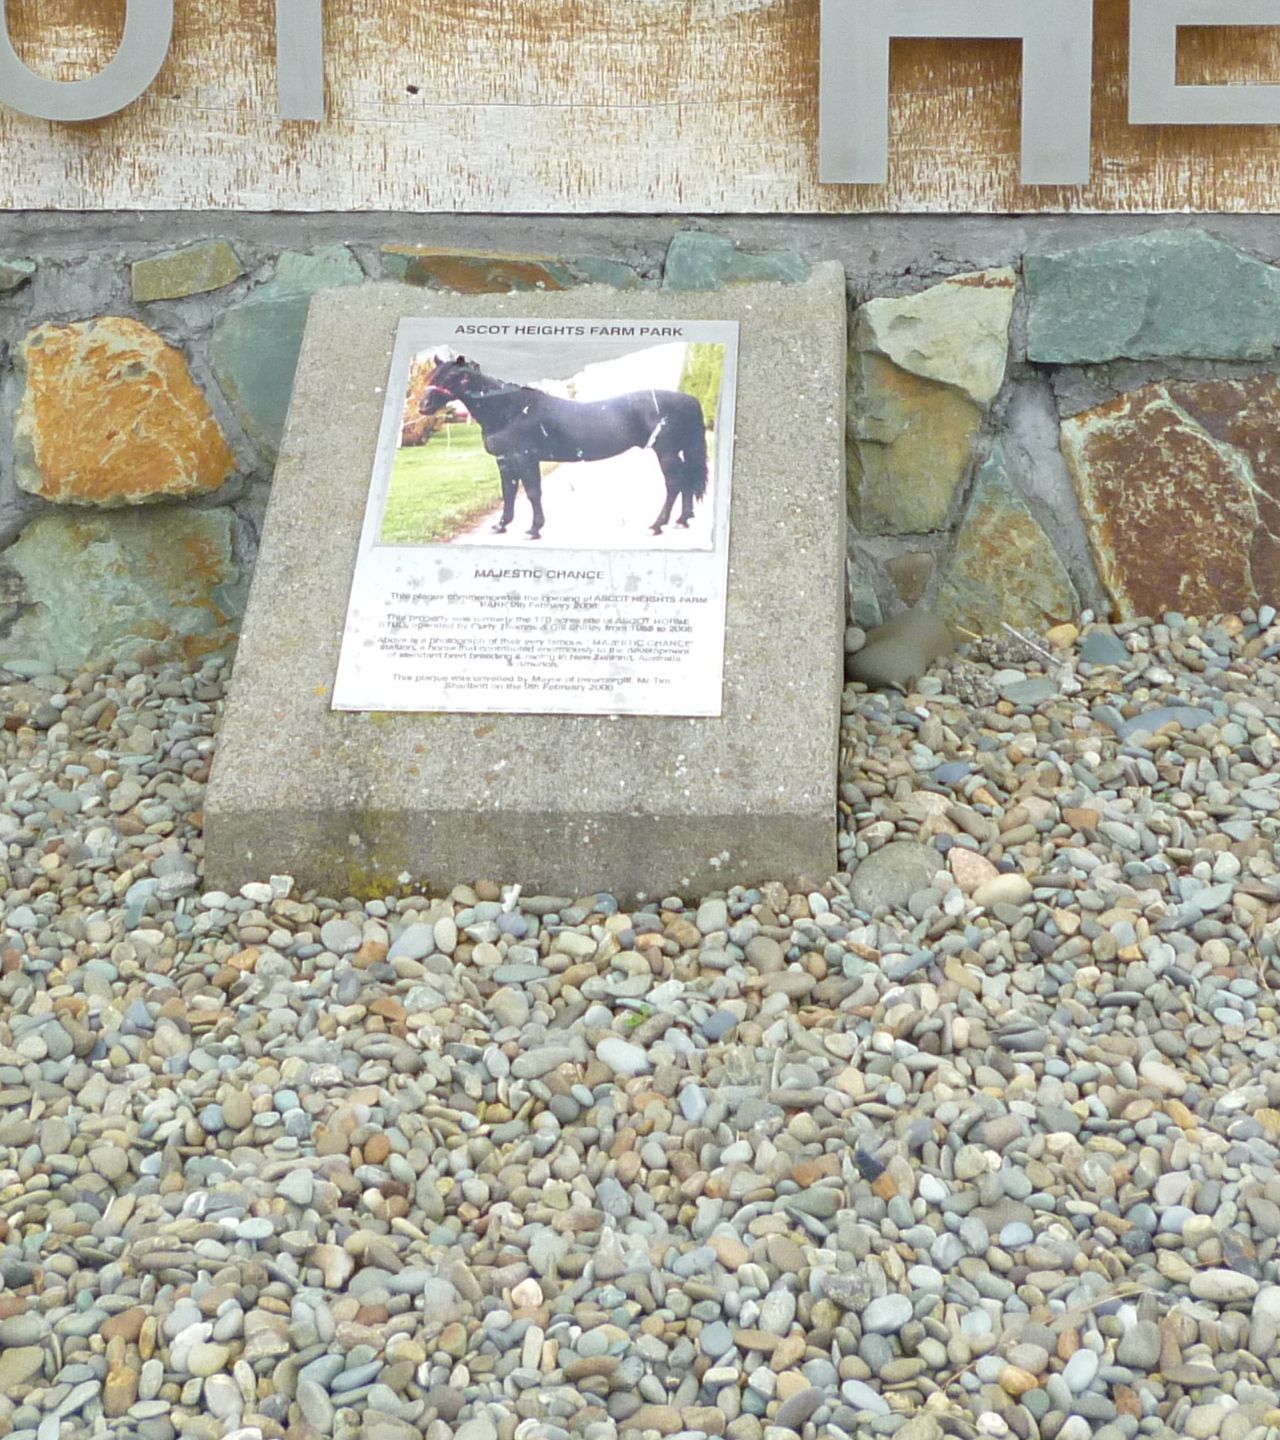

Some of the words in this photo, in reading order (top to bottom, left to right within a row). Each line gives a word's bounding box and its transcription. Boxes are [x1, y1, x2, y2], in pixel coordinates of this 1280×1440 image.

[455, 324, 511, 335] ASCOT
[514, 325, 585, 336] HEIGHTS
[590, 326, 635, 337] FARM
[640, 327, 683, 337] PARK
[474, 569, 542, 579] MAJESTIC
[546, 570, 605, 580] CHANCE
